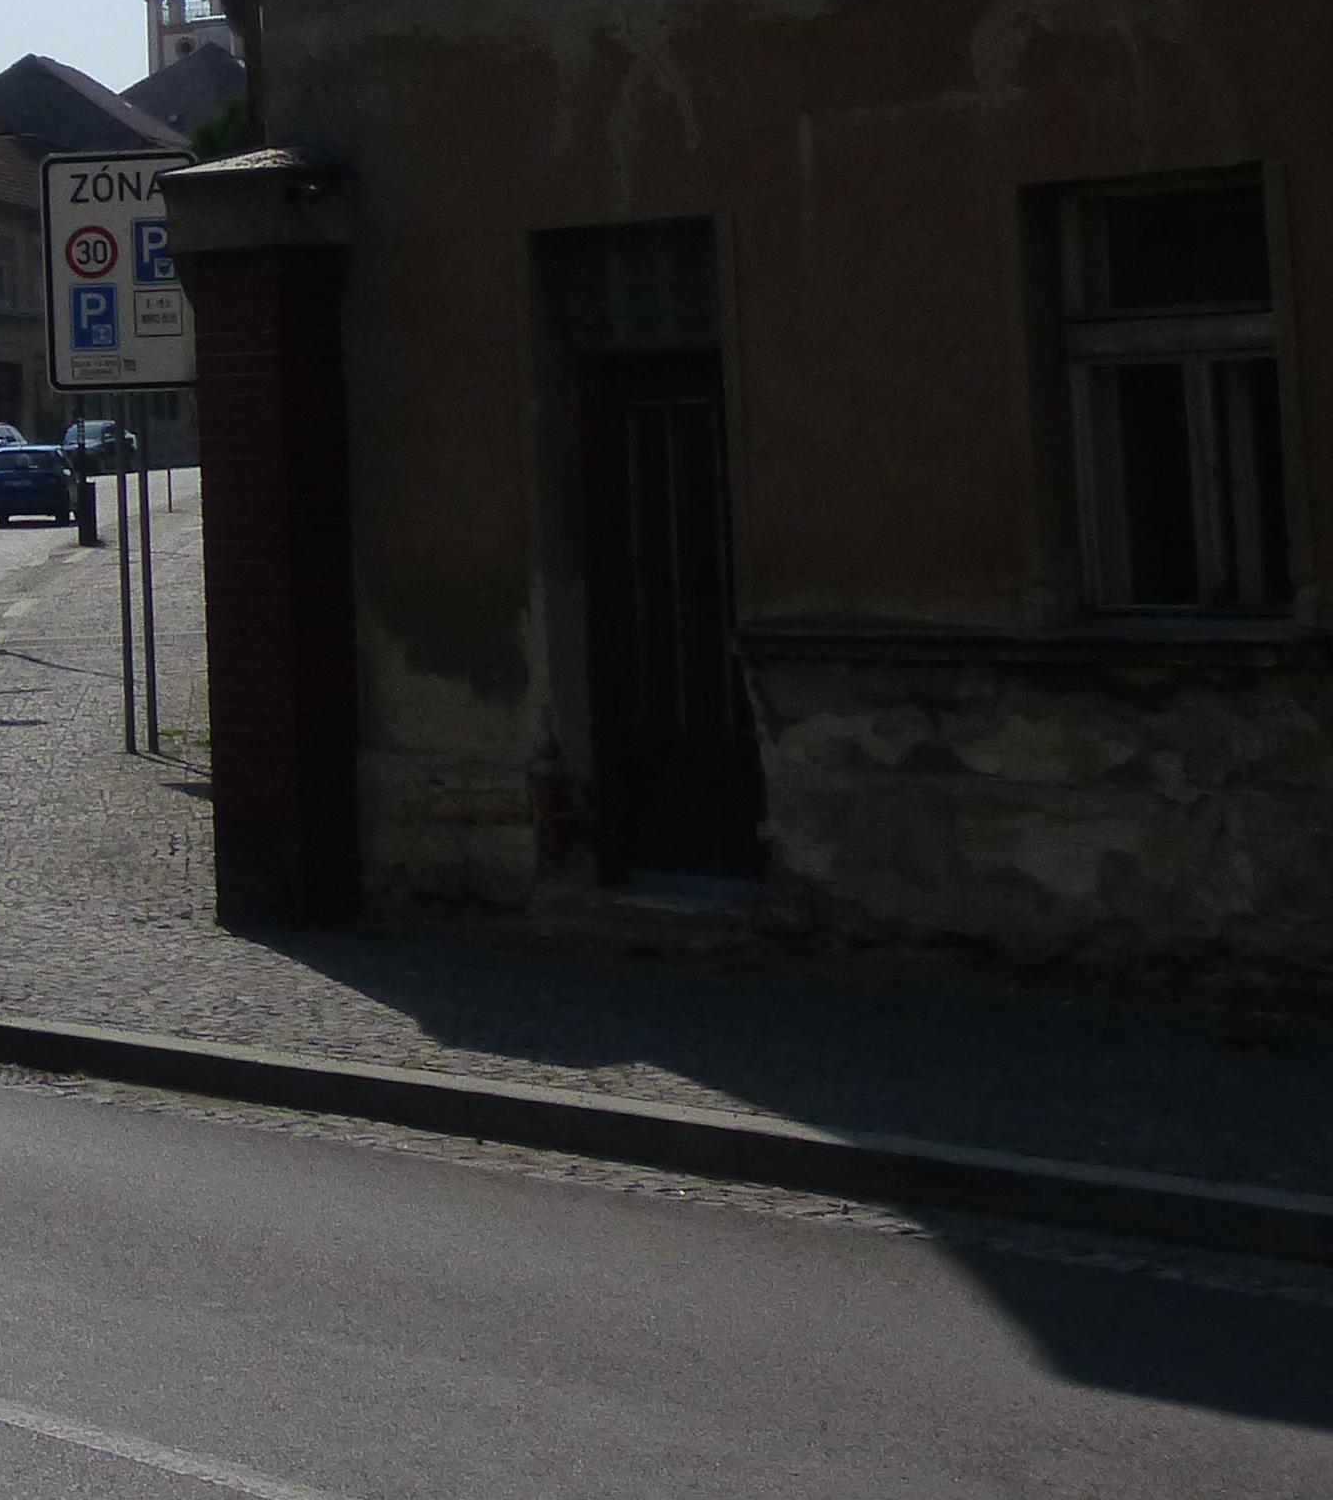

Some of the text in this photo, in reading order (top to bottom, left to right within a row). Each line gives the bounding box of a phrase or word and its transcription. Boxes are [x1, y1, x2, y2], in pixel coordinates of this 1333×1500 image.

[69, 165, 166, 204] ZÓNA
[76, 239, 108, 265] 30
[79, 292, 107, 329] P
